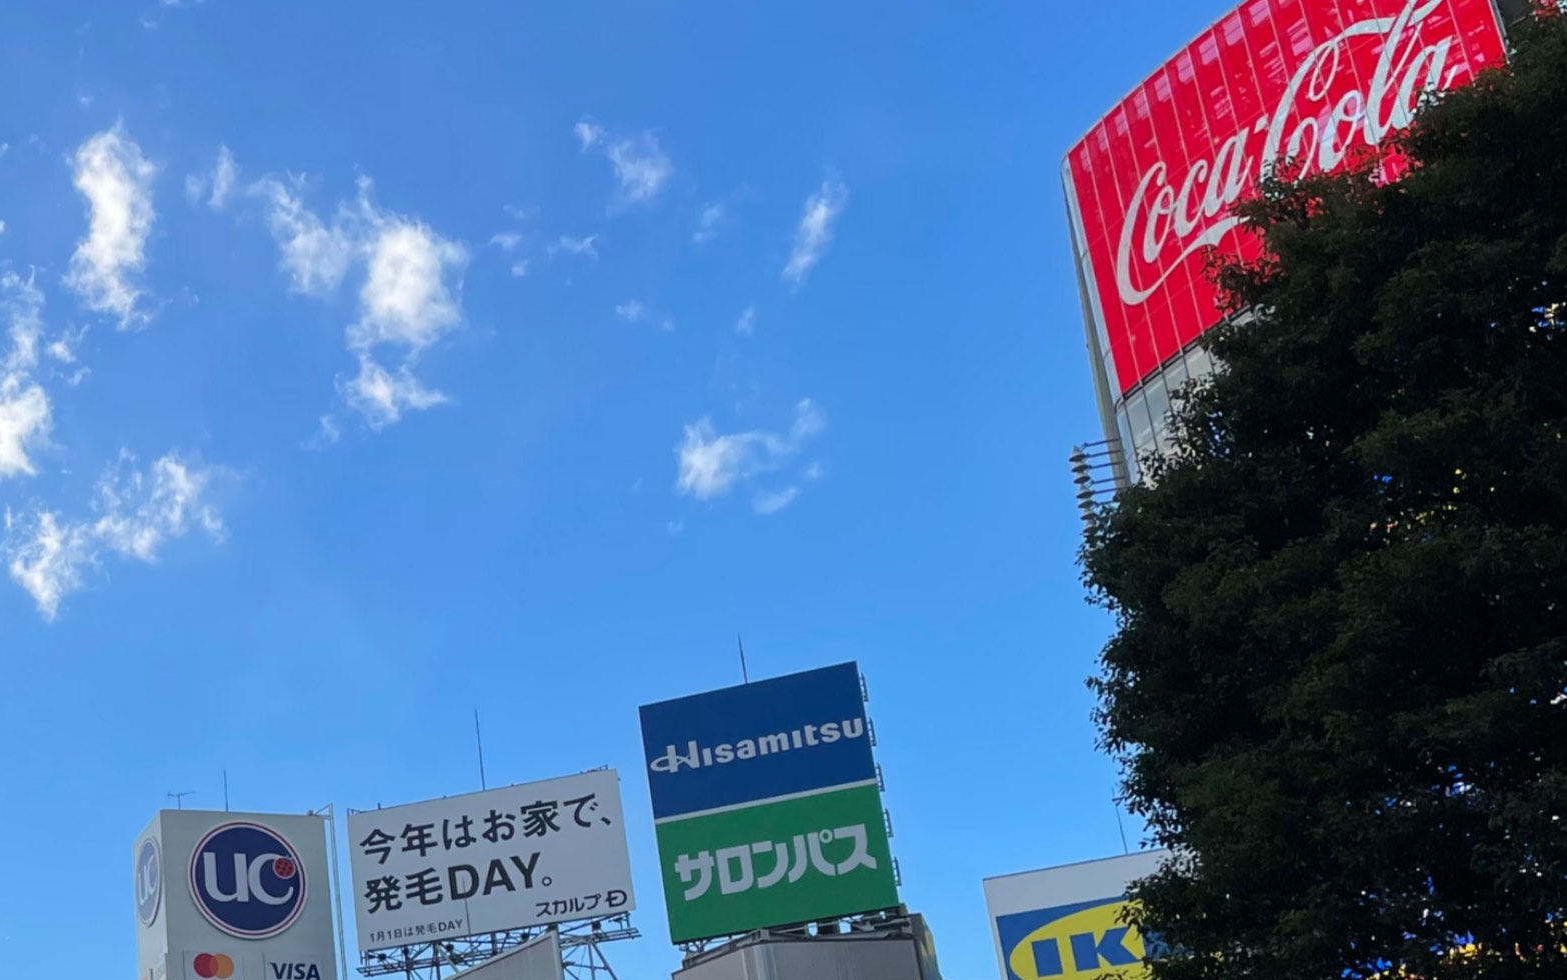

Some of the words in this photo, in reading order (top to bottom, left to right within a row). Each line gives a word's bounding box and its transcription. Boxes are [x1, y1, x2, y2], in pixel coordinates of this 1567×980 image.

[650, 717, 864, 774] Hisamitsu
[359, 792, 612, 865] 今年はお家で、
[363, 852, 553, 915] 発毛DAY。
[674, 823, 878, 902] サロンパス
[269, 962, 321, 980] VISA
